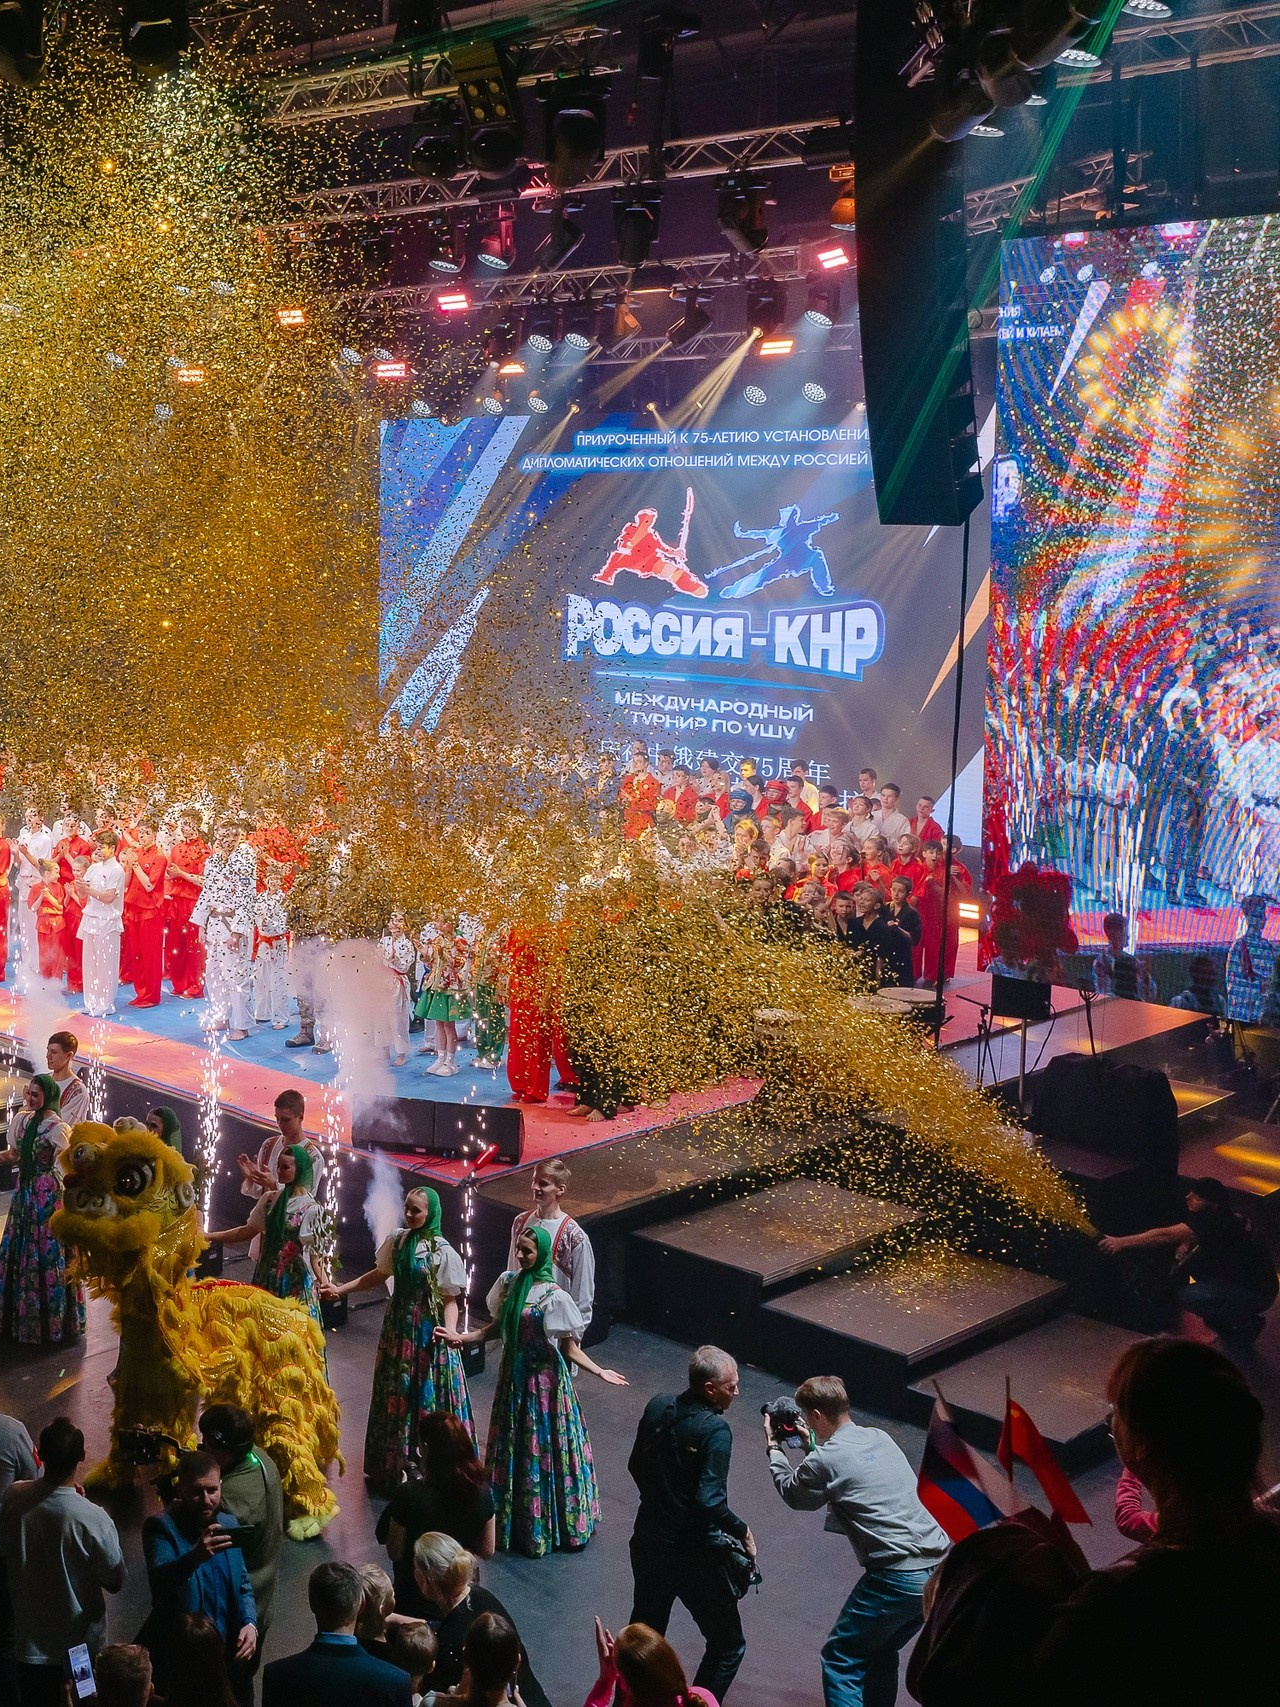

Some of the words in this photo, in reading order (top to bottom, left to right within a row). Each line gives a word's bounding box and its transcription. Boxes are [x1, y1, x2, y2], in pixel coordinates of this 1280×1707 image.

[576, 431, 676, 446] ПРИУРОЧЕННЫЙ
[680, 434, 688, 444] К
[693, 432, 760, 444] 75-ЛЕТИЮ
[763, 428, 869, 443] УСТАНОВЛЕНИ
[522, 457, 645, 470] ДИПЛОМАТИЧЕСКИХ
[648, 453, 733, 468] ОТНОШЕНИЙ
[737, 455, 790, 468] МЕЖДУ
[793, 451, 868, 466] РОССИЕЙ
[615, 691, 814, 722] МЕЖДУНАРОДНЫЙ
[630, 710, 707, 730] ТУРНИР
[712, 719, 742, 734] ПО
[746, 722, 796, 739] УШУ
